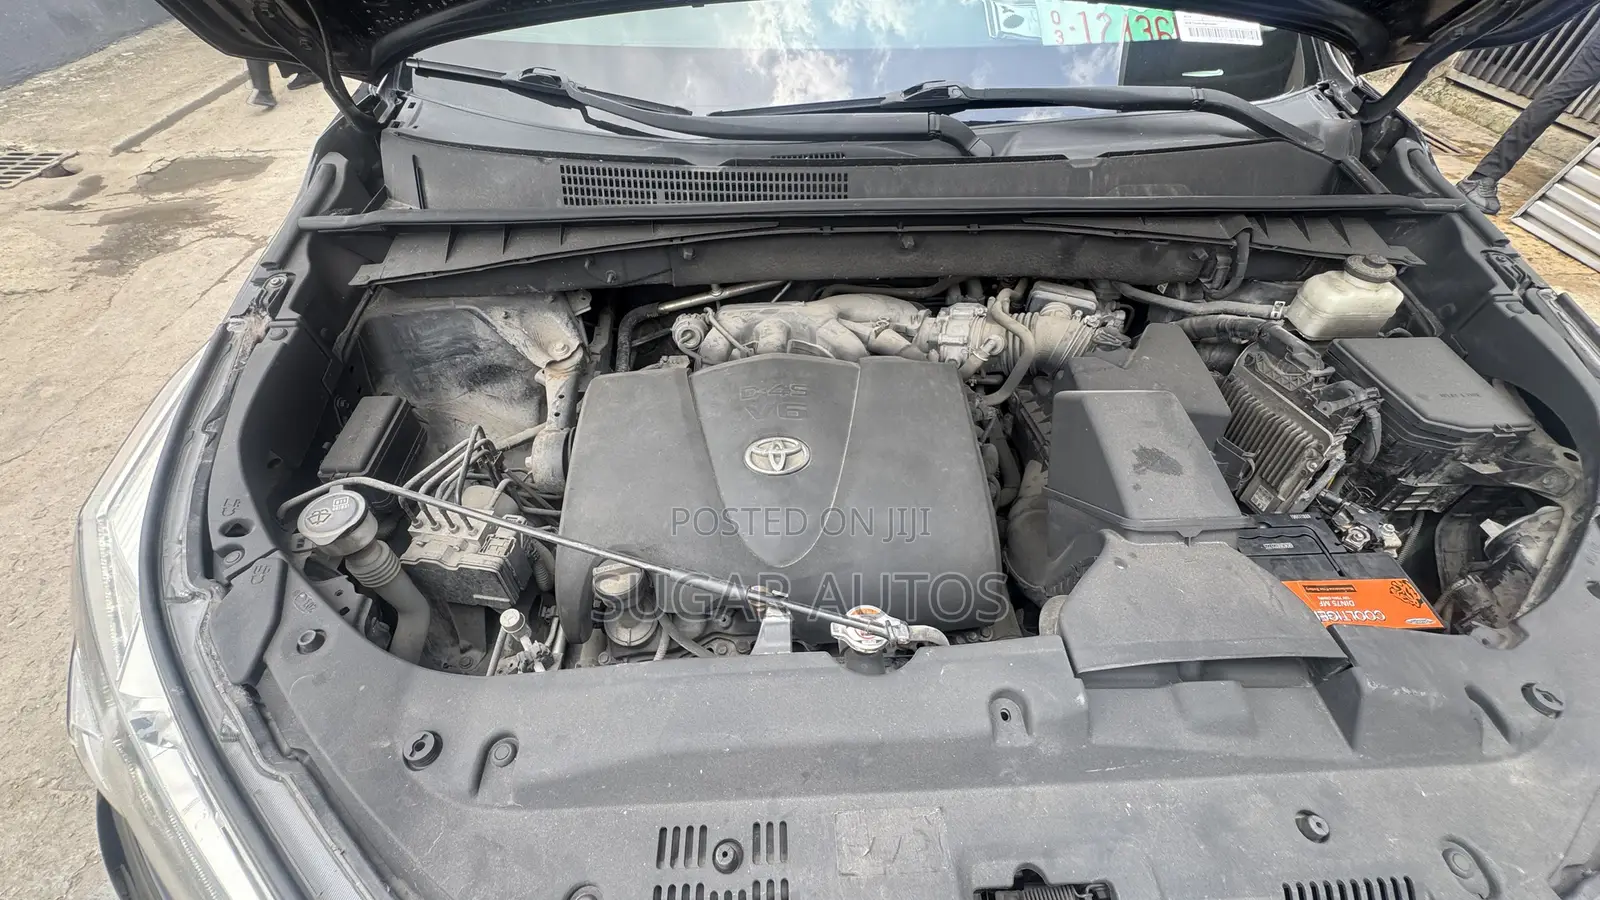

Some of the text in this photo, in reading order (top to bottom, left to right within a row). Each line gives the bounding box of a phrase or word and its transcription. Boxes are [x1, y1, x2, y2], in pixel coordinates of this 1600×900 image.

[740, 384, 807, 401] D-4S
[744, 401, 807, 421] V6
[1314, 609, 1386, 622] COOLTIGE
